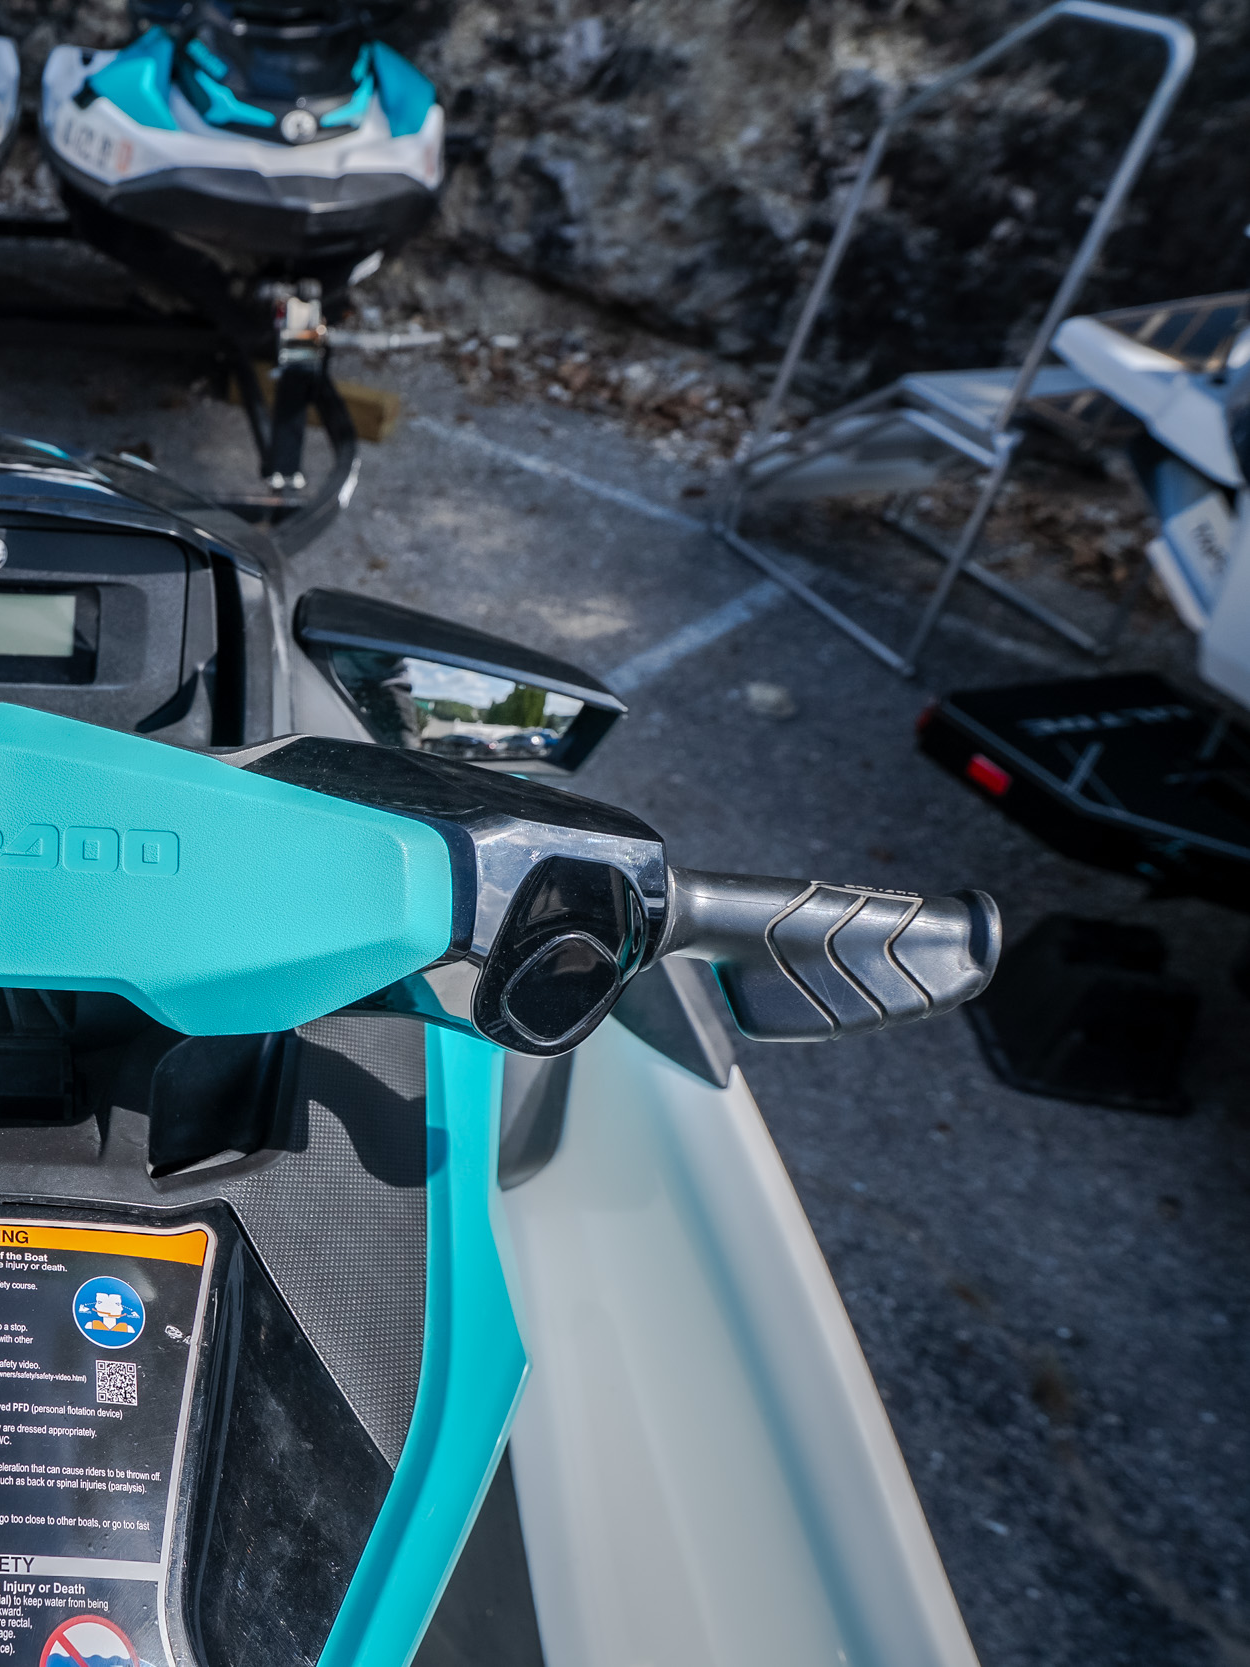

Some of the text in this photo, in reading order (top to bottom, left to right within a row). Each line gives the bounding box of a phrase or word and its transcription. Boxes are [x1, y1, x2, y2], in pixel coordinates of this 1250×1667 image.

[6, 1252, 22, 1260] the
[24, 1253, 48, 1262] Boat
[6, 1261, 28, 1271] injury
[41, 1263, 67, 1272] death.
[18, 1360, 40, 1369] video.
[12, 1403, 29, 1412] PFD
[31, 1404, 66, 1414] (personal
[67, 1406, 96, 1416] flotation
[97, 1408, 123, 1418] device)
[4, 1581, 35, 1595] Injury
[38, 1584, 51, 1593] or
[54, 1582, 85, 1594] Death
[13, 1596, 21, 1605] to
[23, 1596, 43, 1608] keep
[44, 1598, 66, 1607] water
[68, 1598, 86, 1608] from
[88, 1599, 108, 1611] being
